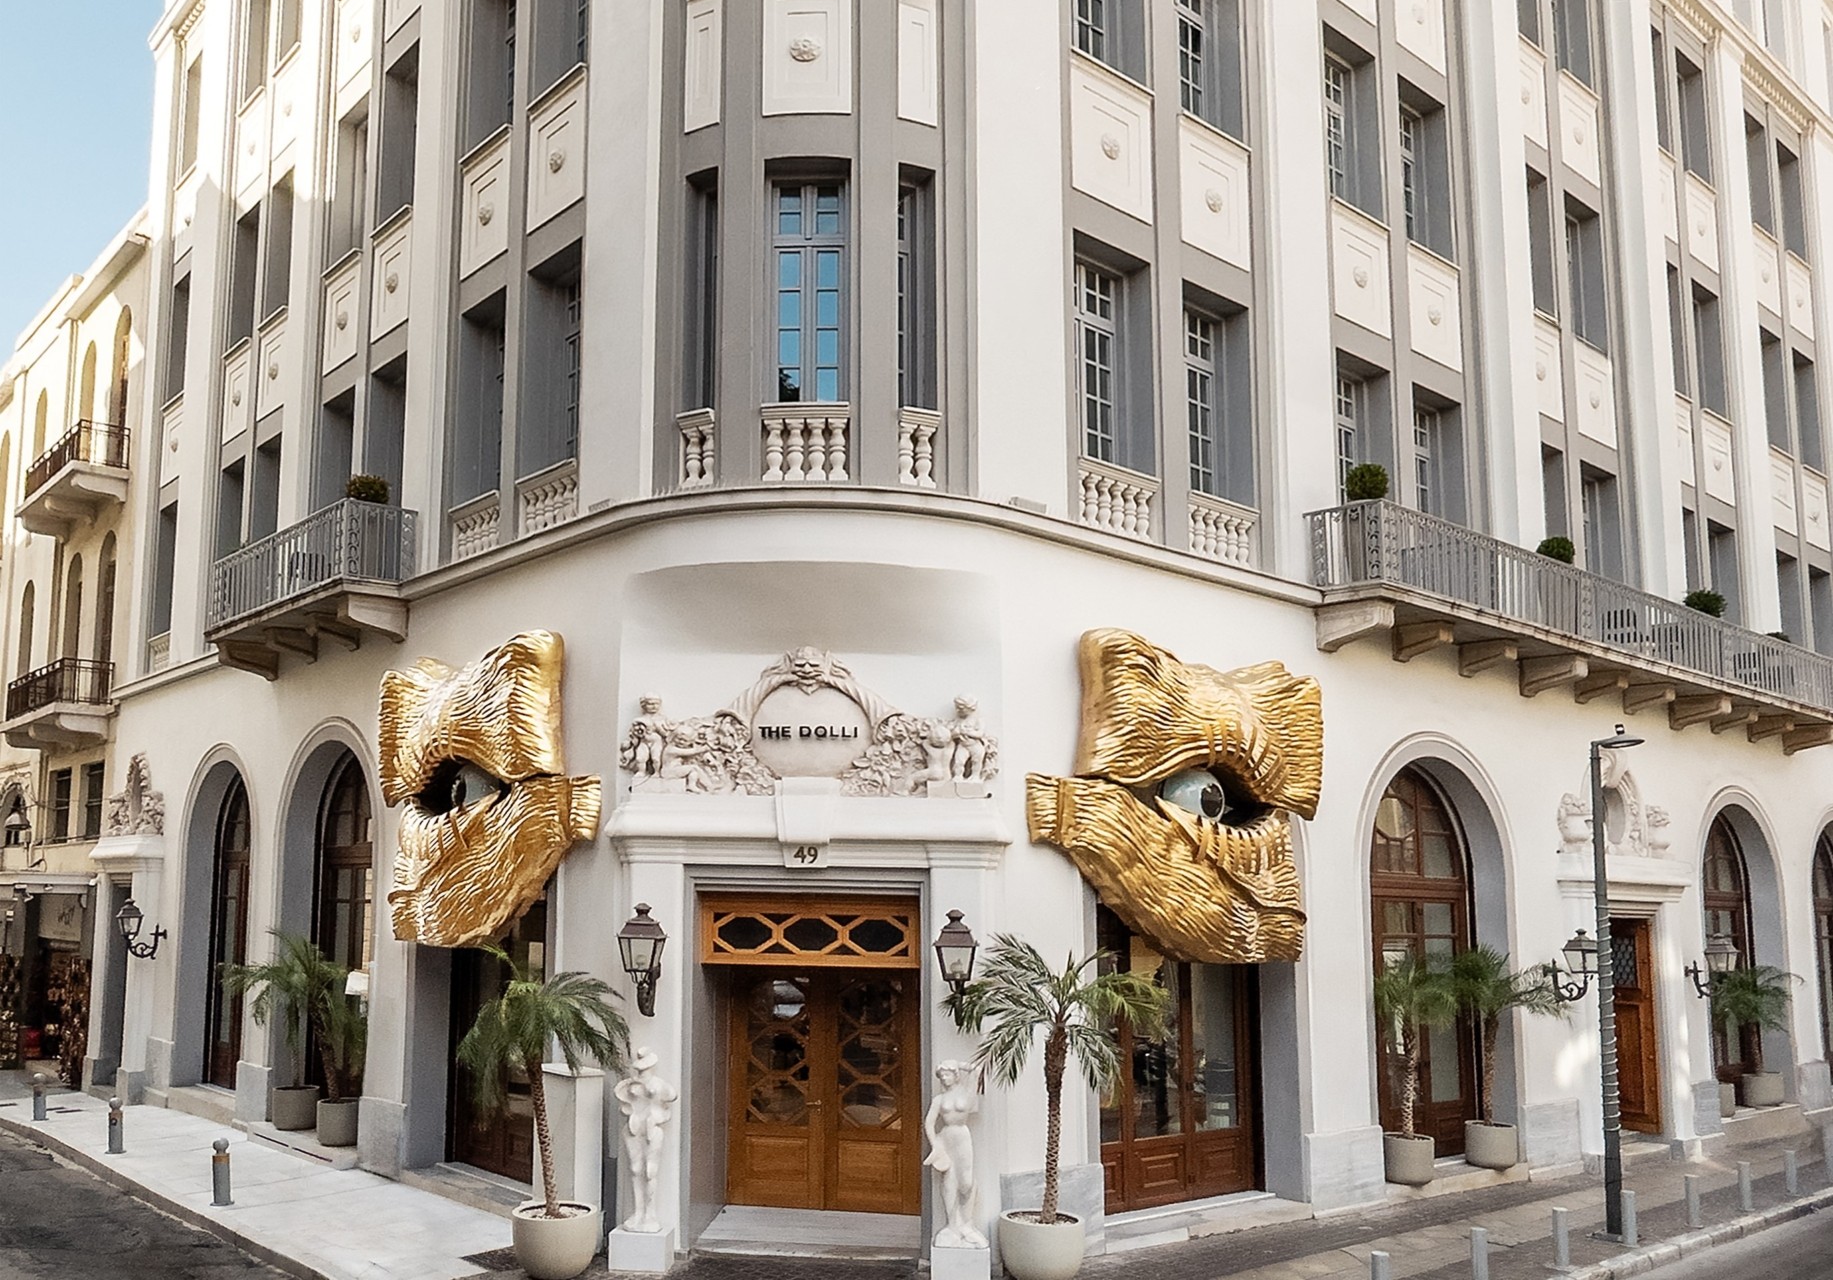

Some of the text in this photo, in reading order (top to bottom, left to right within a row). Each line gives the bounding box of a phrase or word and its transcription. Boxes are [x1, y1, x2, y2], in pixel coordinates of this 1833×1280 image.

[758, 726, 858, 739] THE DOLLI
[793, 846, 818, 864] 49
